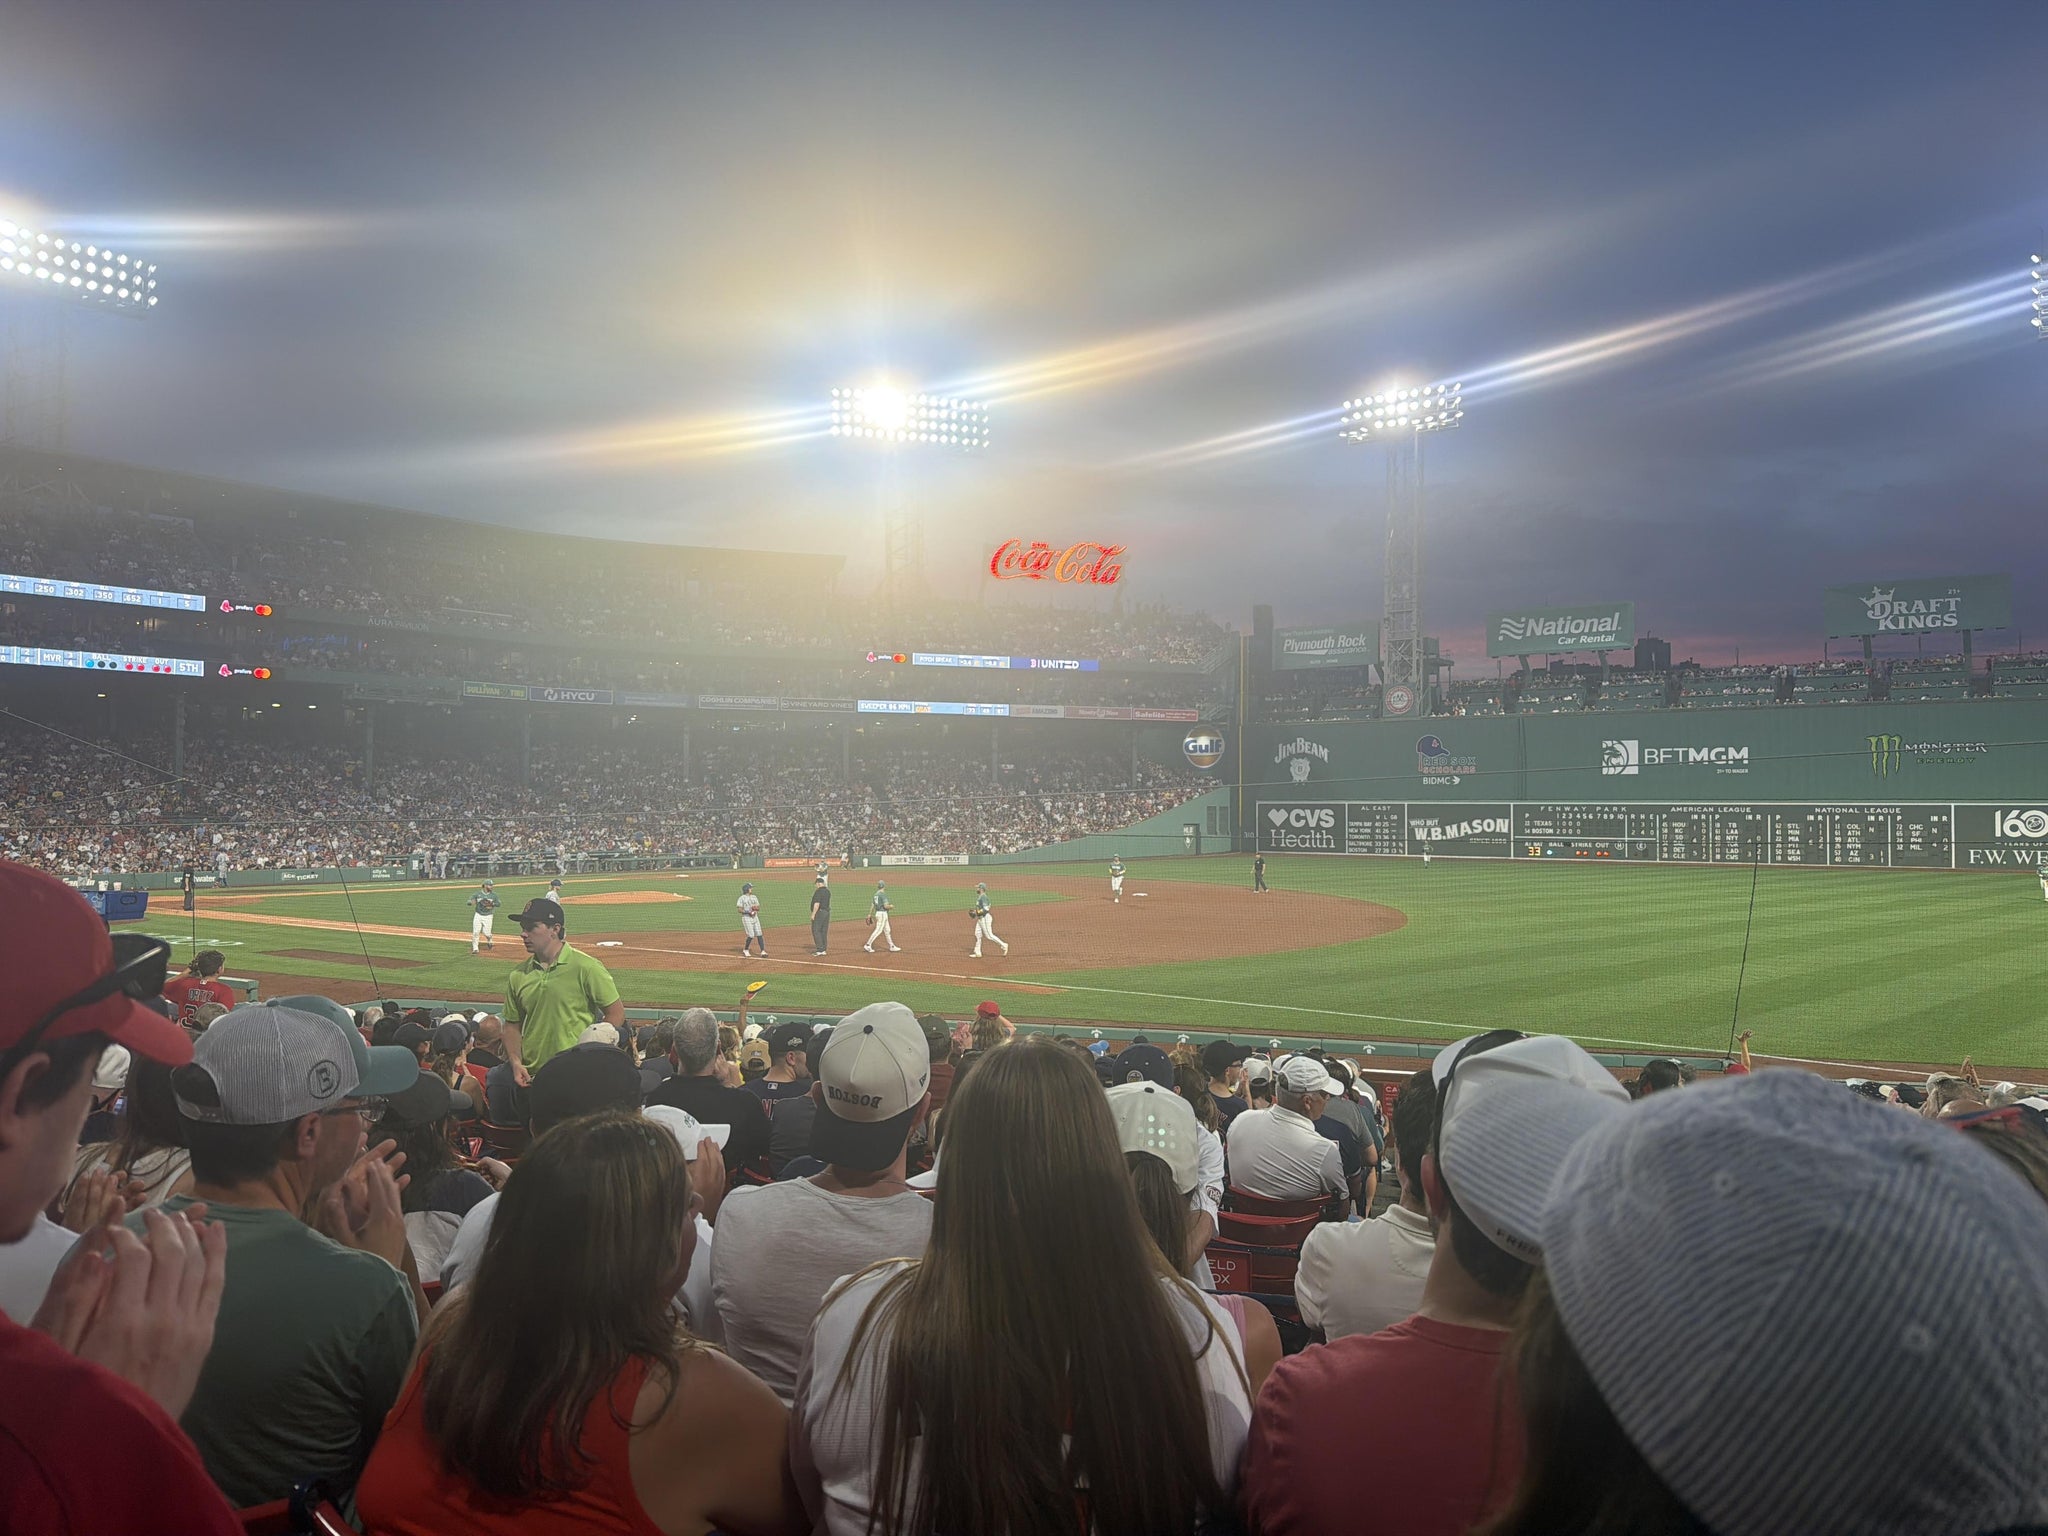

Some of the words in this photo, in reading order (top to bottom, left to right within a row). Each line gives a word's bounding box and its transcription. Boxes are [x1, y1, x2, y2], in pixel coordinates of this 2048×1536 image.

[989, 537, 1127, 584] Coca-Cola
[8, 582, 20, 590] 44
[34, 585, 55, 593] .250
[66, 588, 84, 597] .302
[94, 591, 114, 600] .350
[123, 594, 142, 603] .652
[1866, 598, 1961, 620] DRAFT
[1526, 612, 1620, 637] National
[1878, 613, 1958, 630] KINGS
[1282, 636, 1335, 653] Plymouth
[1336, 632, 1367, 648] Rock
[1558, 636, 1576, 645] Car
[1580, 634, 1616, 644] Rental
[1328, 646, 1367, 656] assurance
[43, 654, 62, 662] MVR
[123, 656, 147, 664] STRIKE
[179, 662, 198, 672] 5TH
[1041, 660, 1080, 670] UNITED
[560, 692, 596, 702] HYCU
[1184, 739, 1222, 754] Gulf
[1274, 742, 1296, 764] JIM
[1296, 737, 1330, 764] BEAM
[1905, 742, 1988, 754] MONSTER
[1423, 756, 1448, 766] RED
[1450, 756, 1476, 766] SOX
[1644, 746, 1748, 766] BETMGM
[1422, 766, 1476, 774] SCHOLARS
[1422, 776, 1450, 785] BIDMC
[1289, 808, 1336, 828] CVS
[1994, 810, 2048, 838] 160
[1270, 829, 1336, 848] Health
[1528, 846, 1541, 856] 33
[1968, 849, 2006, 864] F.W.
[188, 988, 214, 1002] ORTIZ
[828, 1085, 882, 1108] BOSTON
[1208, 1259, 1236, 1271] ELD
[1212, 1273, 1230, 1284] OX
